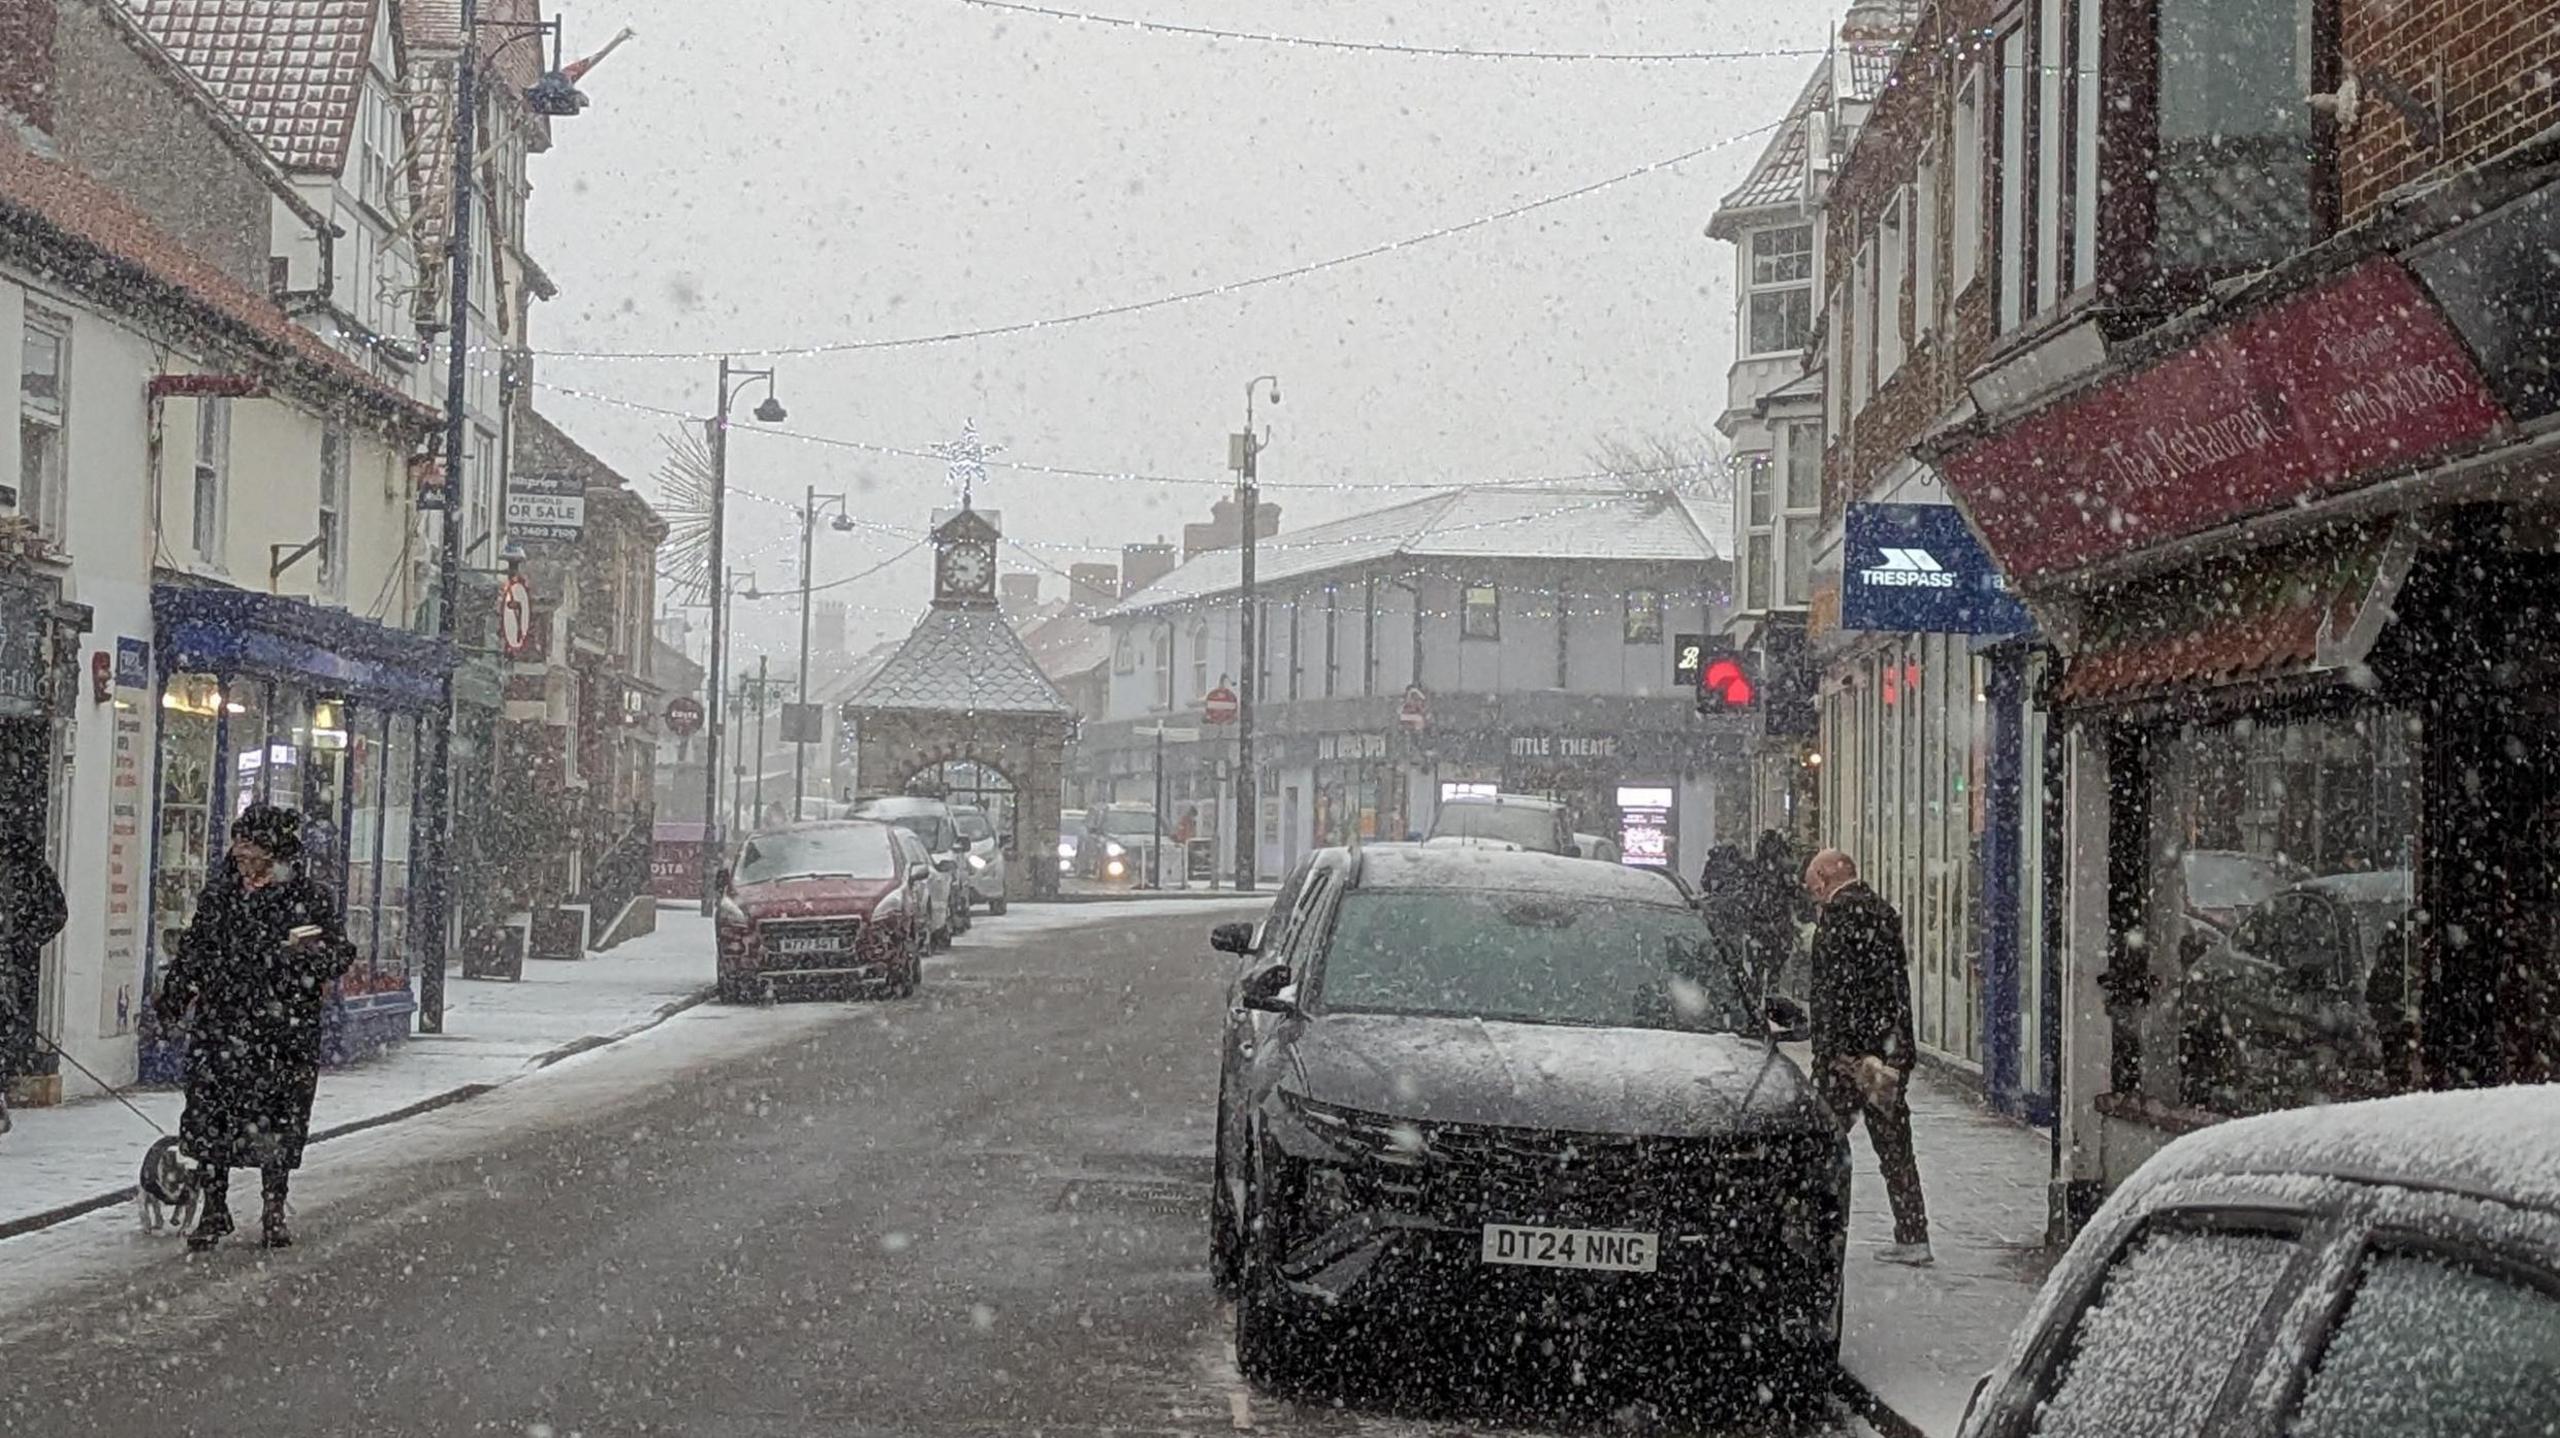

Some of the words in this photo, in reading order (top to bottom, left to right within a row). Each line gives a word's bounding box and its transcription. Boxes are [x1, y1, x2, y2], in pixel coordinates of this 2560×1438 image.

[2146, 400, 2284, 475] Restaurant
[508, 504, 531, 518] OR
[536, 505, 576, 520] SALE
[1860, 569, 1954, 587] TRESPASS
[650, 862, 684, 876] OSTA
[1497, 1229, 1576, 1262] DT24
[1586, 1235, 1645, 1266] NNG
